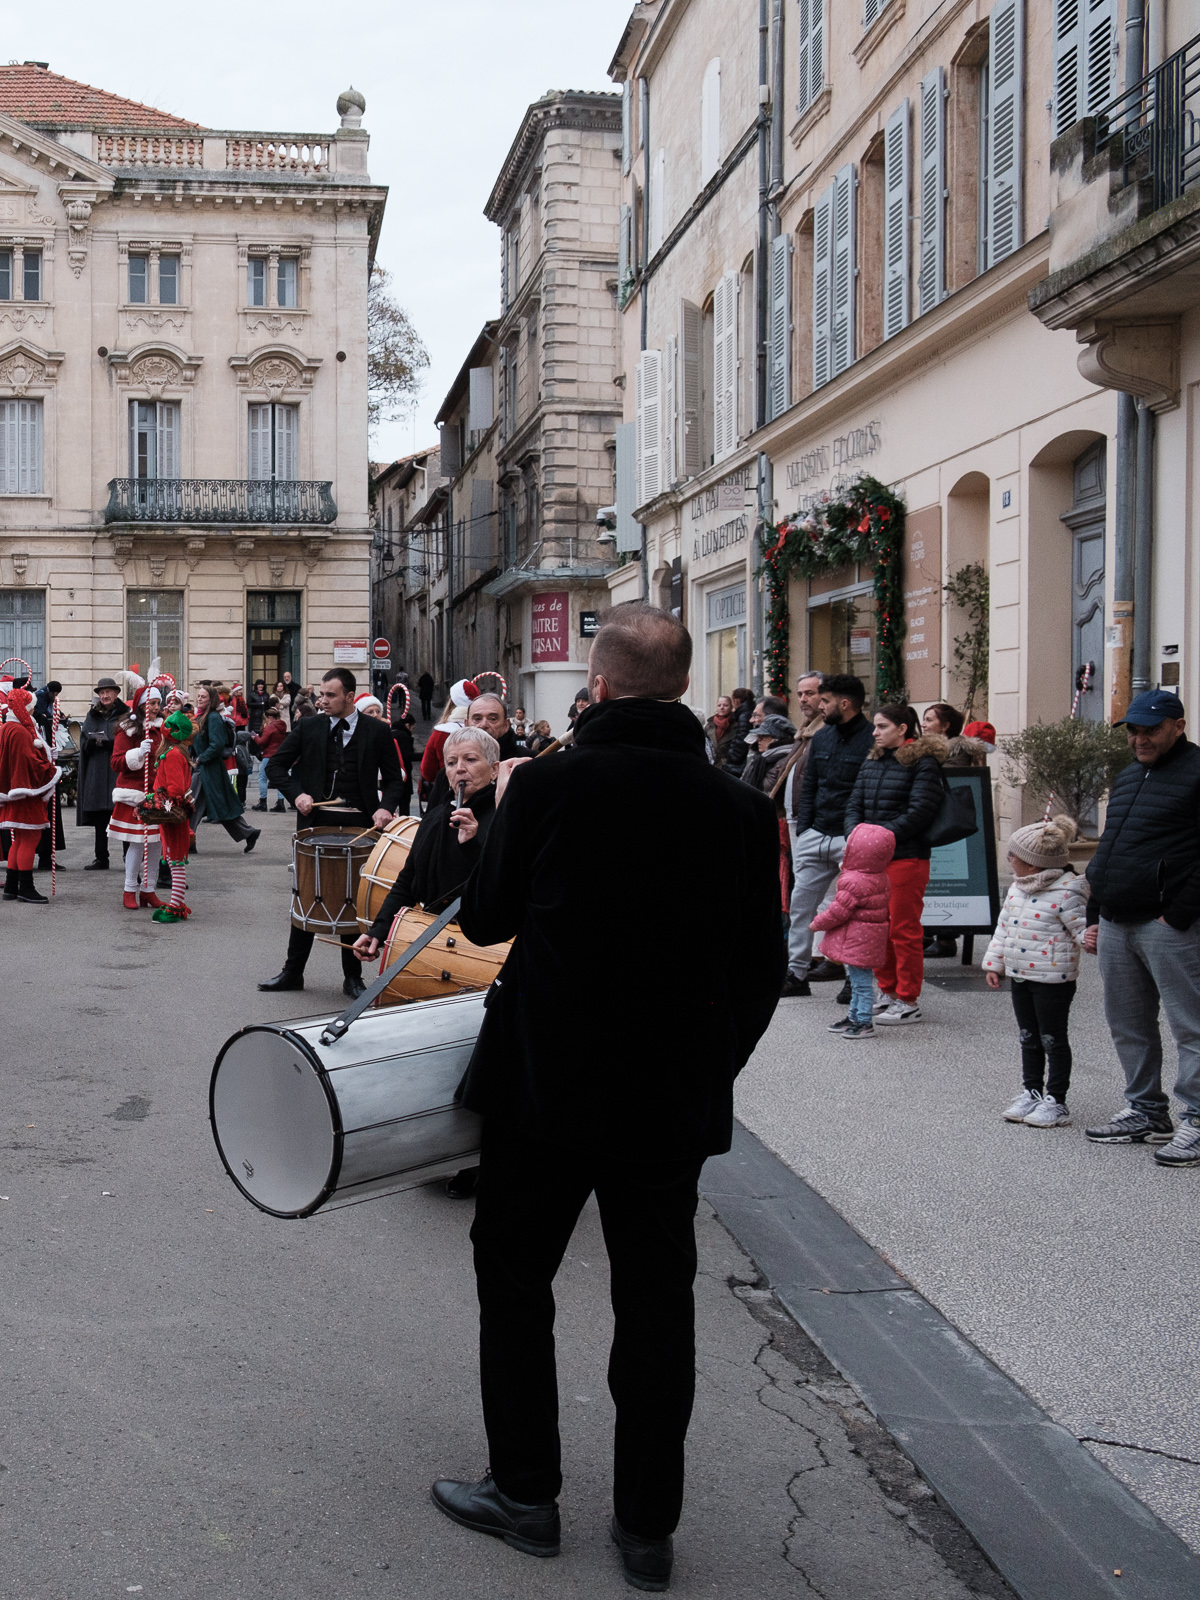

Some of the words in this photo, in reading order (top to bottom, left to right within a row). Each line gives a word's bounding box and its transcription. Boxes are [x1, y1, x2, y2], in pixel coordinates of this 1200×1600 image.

[1003, 492, 1009, 506] 18
[702, 513, 749, 557] LUNETTES
[549, 599, 563, 611] de
[715, 591, 746, 621] OPTICIE
[533, 617, 559, 634] AITRE
[933, 900, 969, 909] boutique
